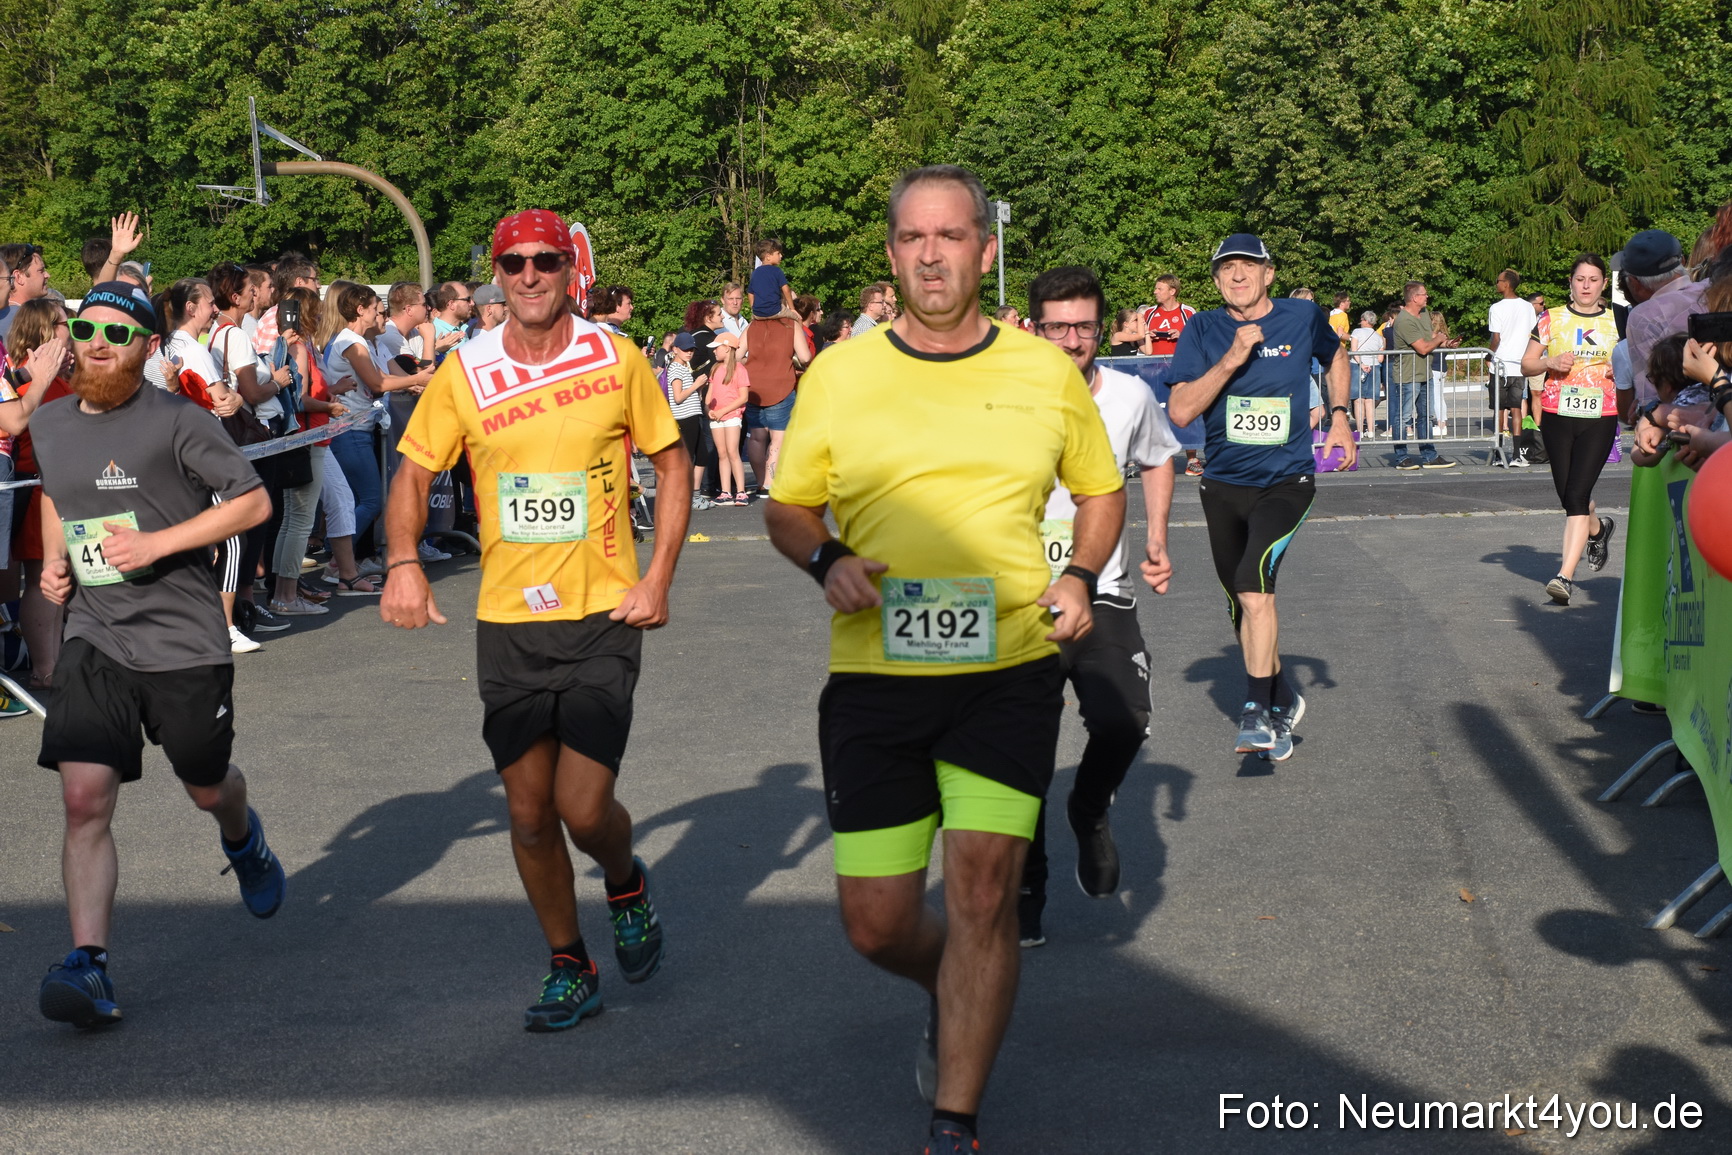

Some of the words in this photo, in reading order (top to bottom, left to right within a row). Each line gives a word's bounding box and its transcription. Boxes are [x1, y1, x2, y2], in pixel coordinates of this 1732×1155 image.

[1257, 346, 1280, 358] vhs
[481, 397, 548, 436] MAX
[553, 374, 624, 408] BÖGL
[1565, 396, 1598, 410] 1318
[1233, 413, 1281, 432] 2399
[95, 477, 137, 486] BURKHARDT
[508, 497, 576, 523] 1599
[518, 523, 539, 531] Höller
[540, 523, 565, 531] Lorenz
[894, 608, 980, 639] 2192
[906, 640, 943, 649] Miehling
[945, 640, 970, 648] Franz
